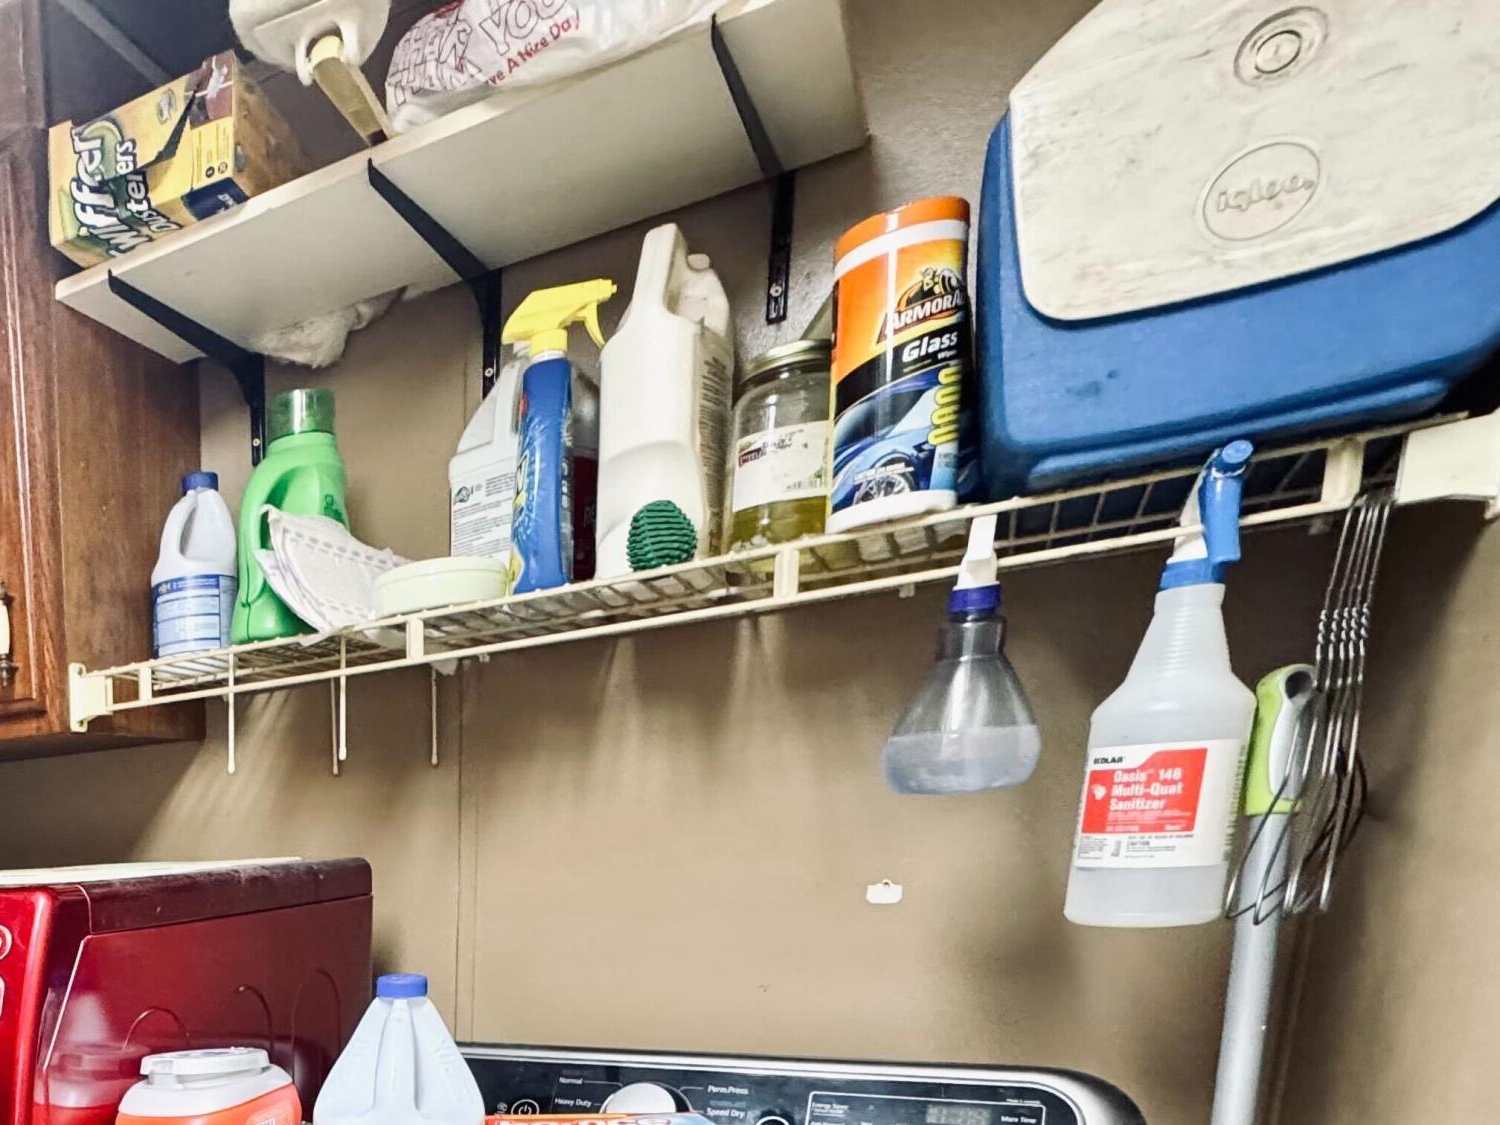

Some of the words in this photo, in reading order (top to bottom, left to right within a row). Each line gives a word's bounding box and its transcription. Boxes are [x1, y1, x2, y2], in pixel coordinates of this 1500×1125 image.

[506, 57, 520, 74] A
[549, 7, 580, 41] Day
[71, 126, 152, 257] wiffer
[902, 331, 958, 363] Glass
[1111, 783, 1183, 797] Multi-Quat
[1109, 798, 1166, 810] Sanitizer
[554, 1097, 575, 1107] Heavy
[575, 1098, 592, 1108] Duty
[706, 1106, 730, 1118] Speed
[731, 1109, 746, 1119] Dry
